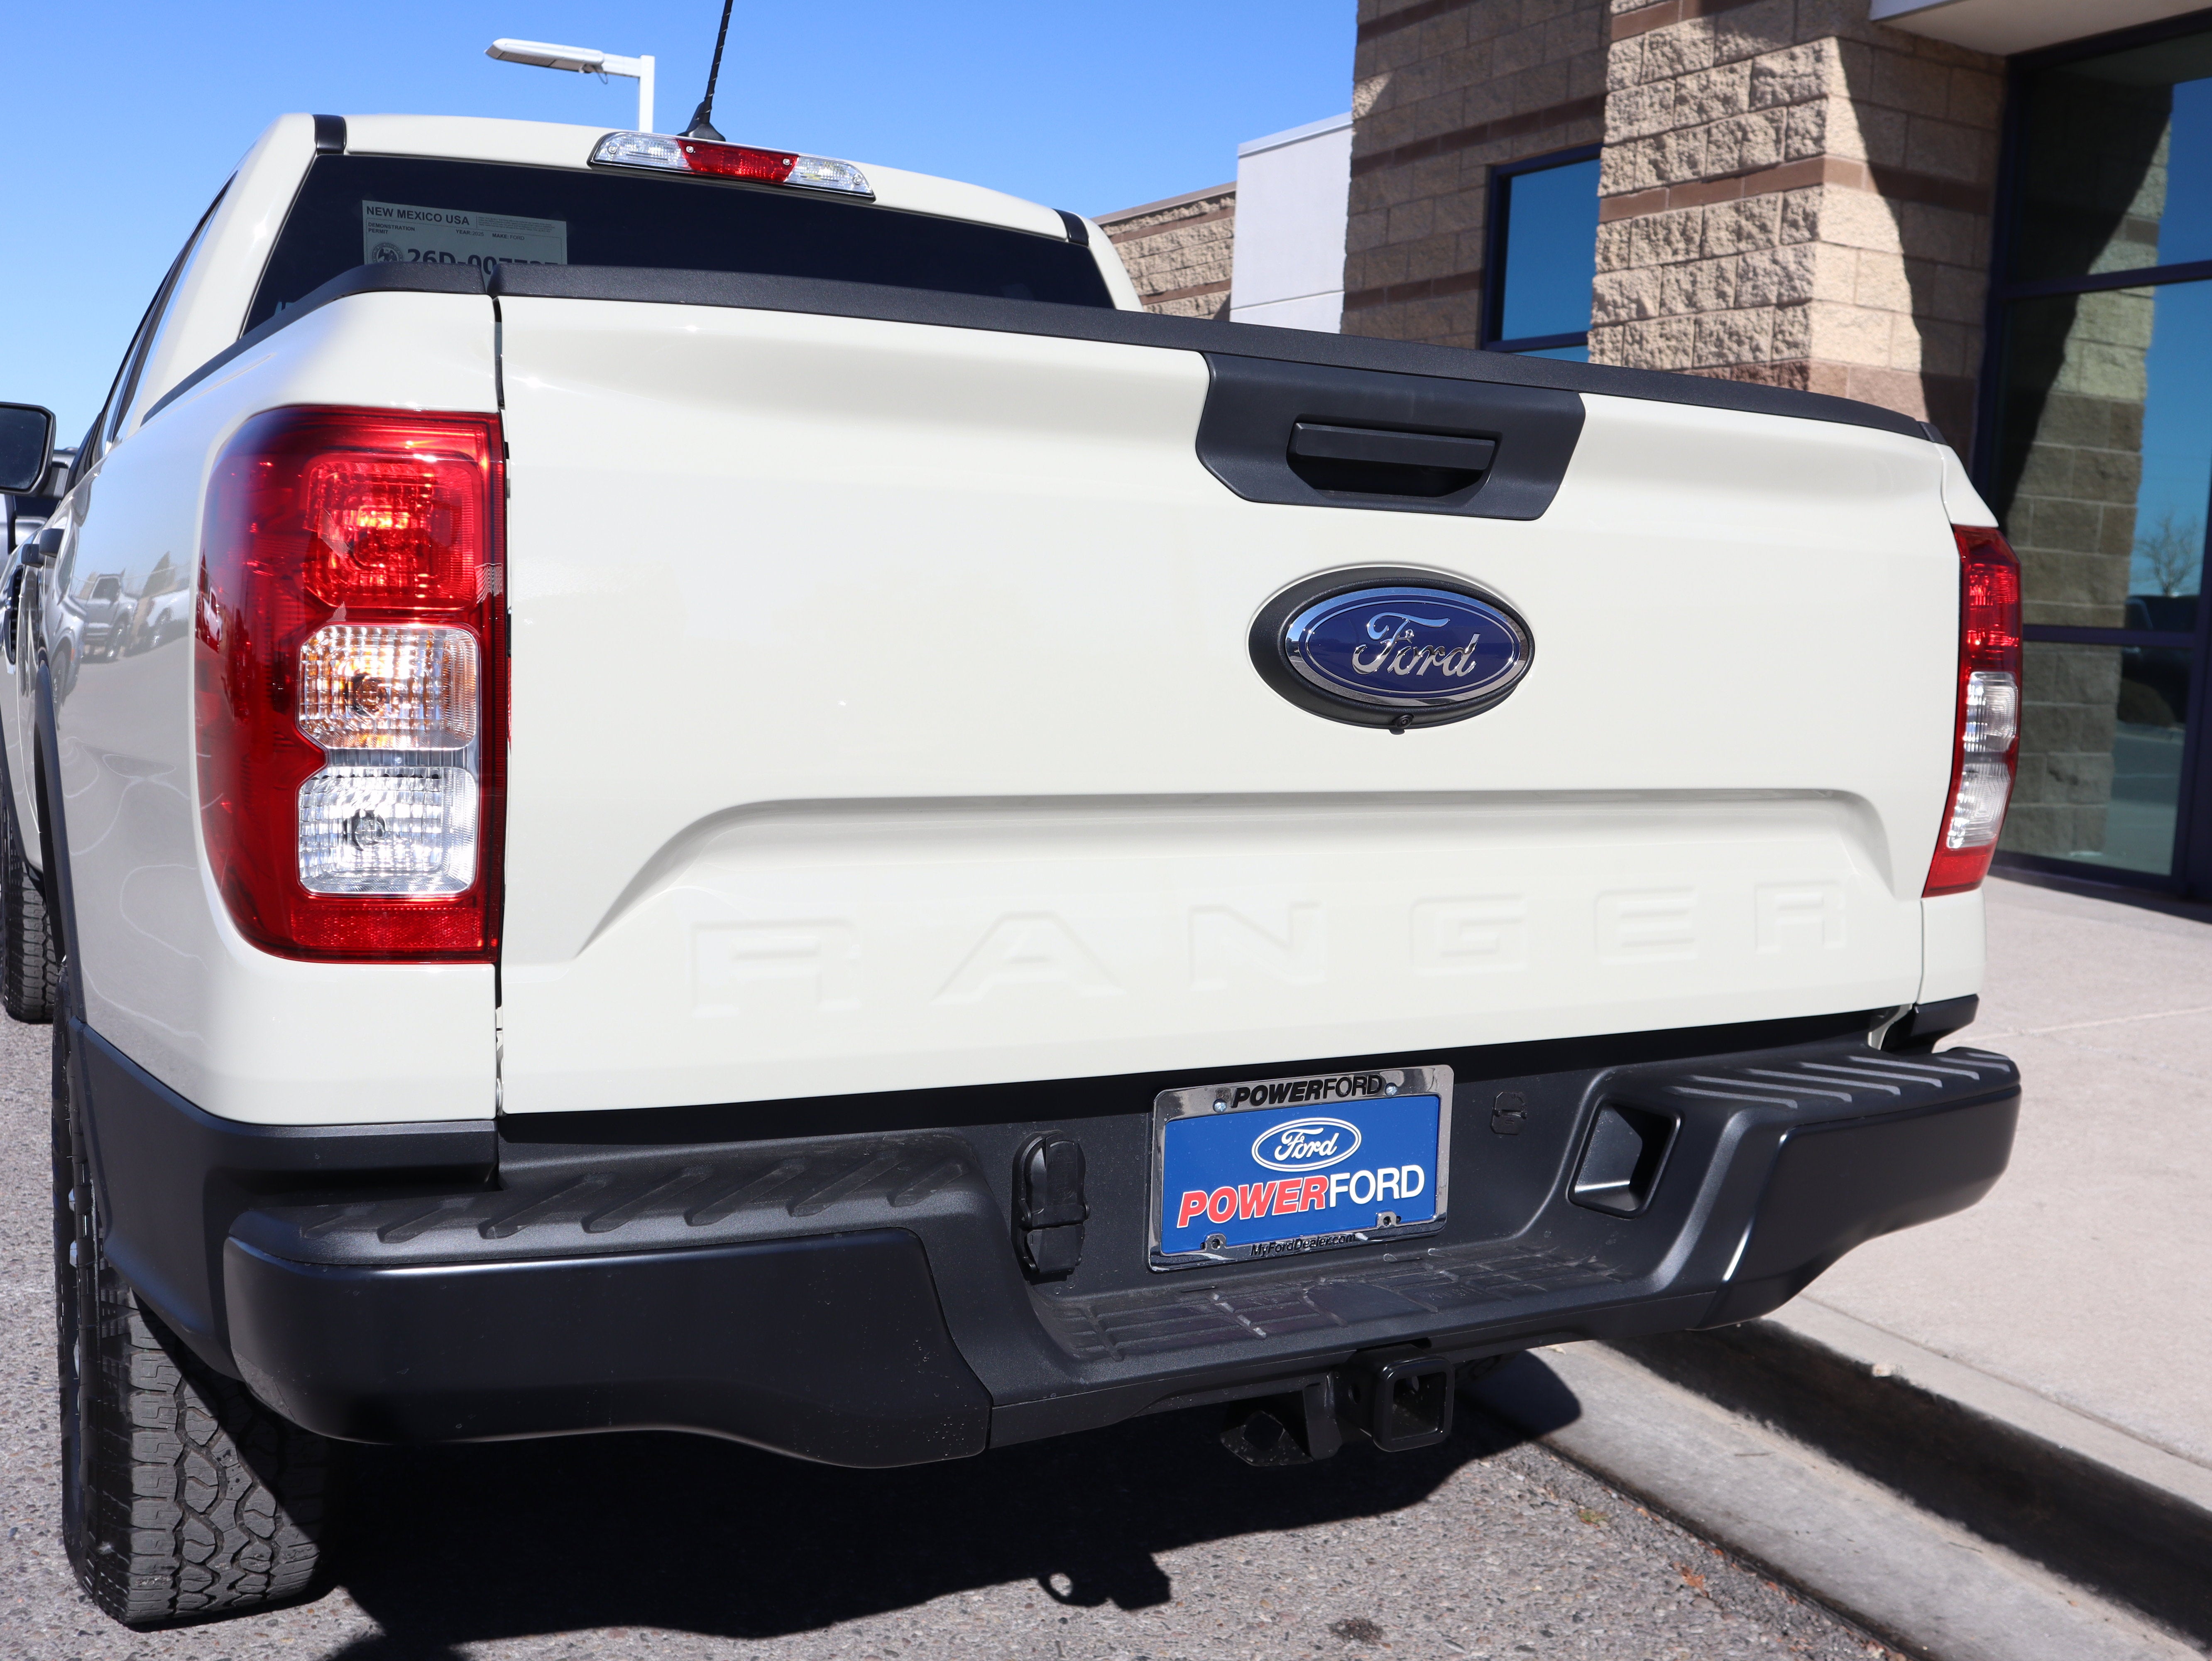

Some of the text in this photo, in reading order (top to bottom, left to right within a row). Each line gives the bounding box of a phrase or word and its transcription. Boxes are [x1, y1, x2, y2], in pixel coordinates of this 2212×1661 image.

[367, 206, 394, 217] NEW
[397, 209, 442, 222] MEXICO
[446, 215, 470, 225] USA
[368, 222, 415, 231] DEMONSTRATION
[1351, 612, 1481, 677] Ford
[689, 879, 1846, 1018] RANGER
[1231, 1075, 1382, 1108] POWERFORD
[1274, 1127, 1339, 1161] Ford
[1176, 1165, 1425, 1228] POWERFORD
[1250, 1233, 1356, 1257] MyFordDealer.com
